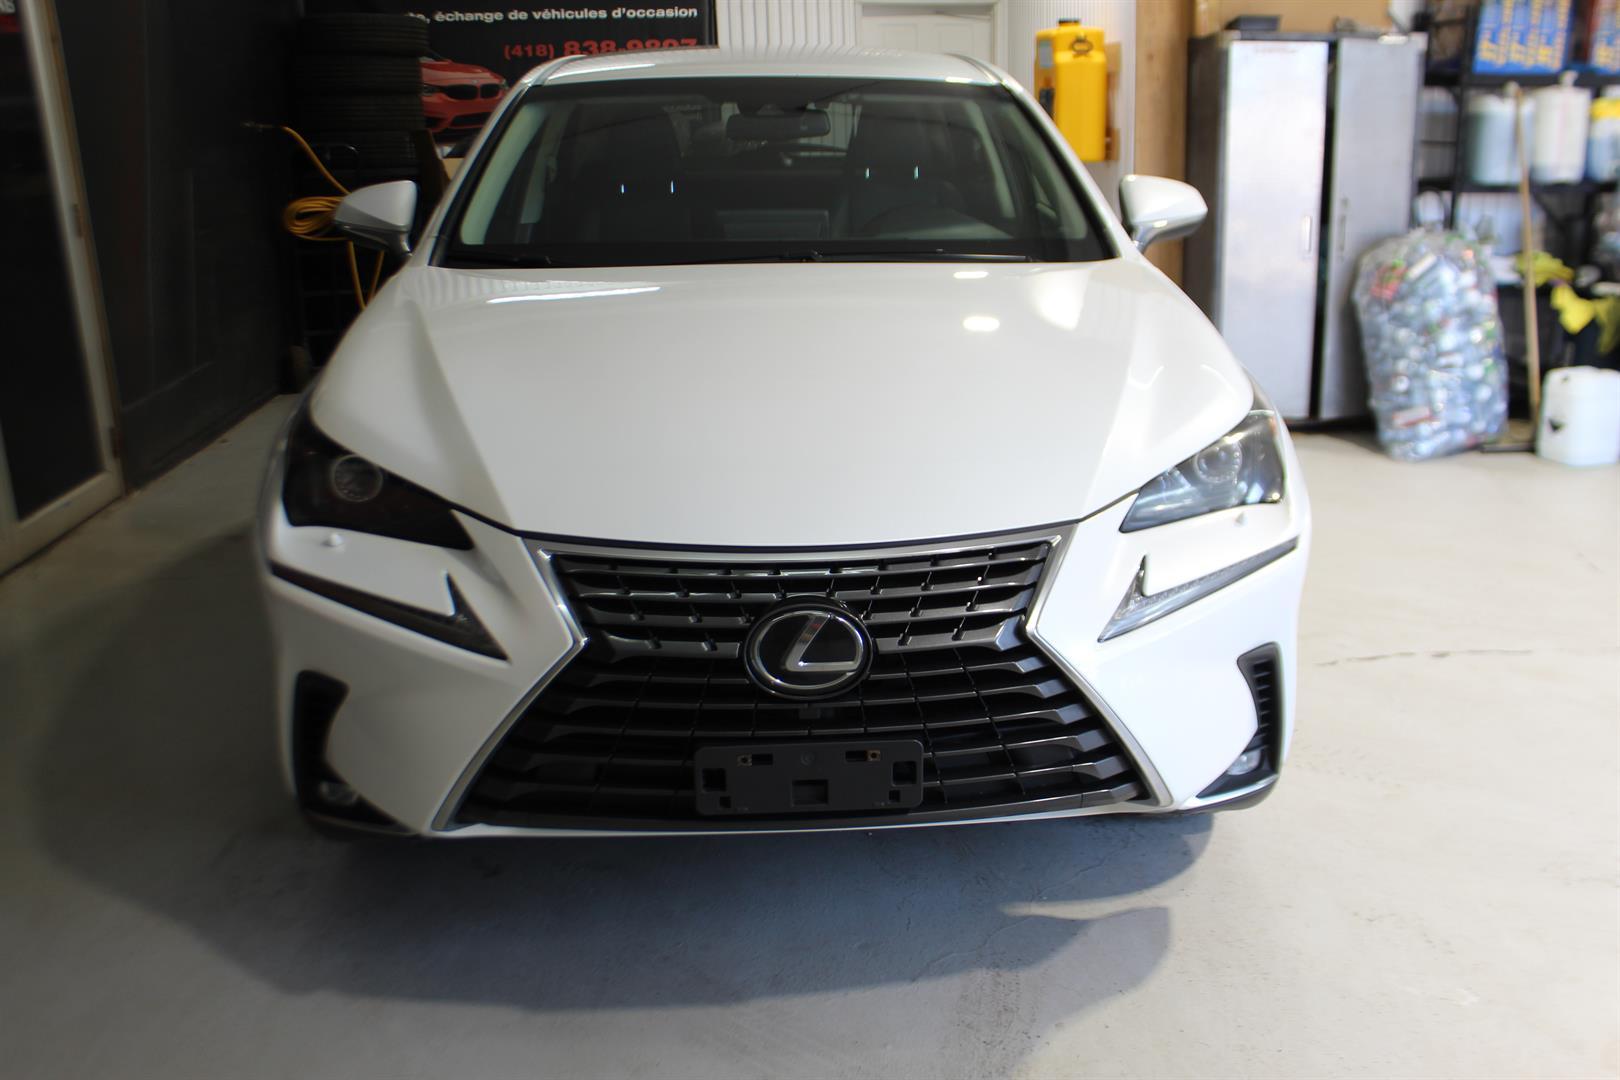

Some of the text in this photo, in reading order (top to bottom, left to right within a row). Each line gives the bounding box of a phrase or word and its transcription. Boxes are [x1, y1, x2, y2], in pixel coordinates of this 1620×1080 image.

[434, 11, 504, 23] échange
[508, 9, 528, 20] de
[532, 8, 607, 20] véhicules
[612, 6, 698, 18] d'occasion
[504, 43, 555, 60] (418)
